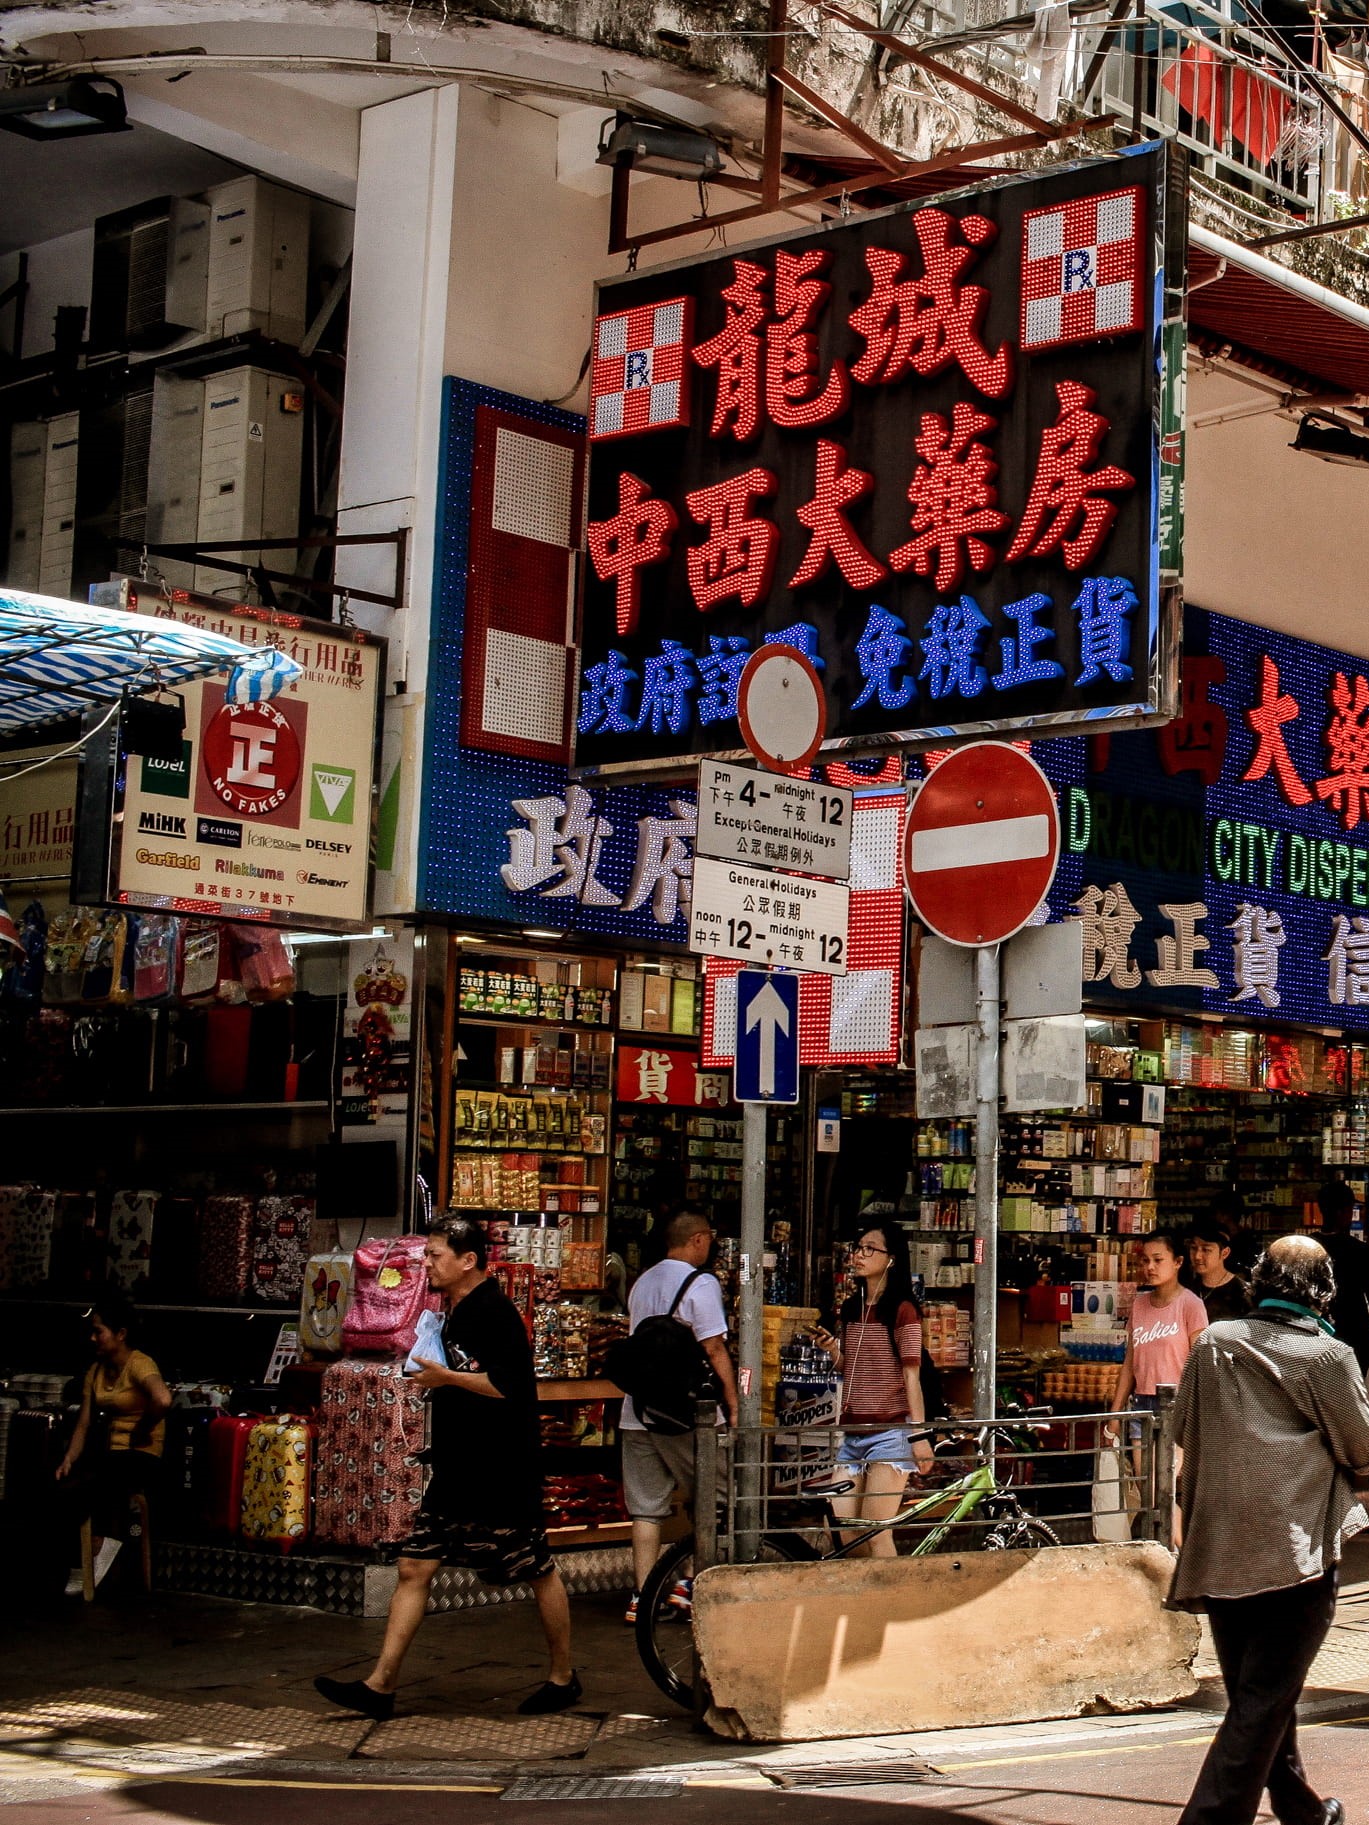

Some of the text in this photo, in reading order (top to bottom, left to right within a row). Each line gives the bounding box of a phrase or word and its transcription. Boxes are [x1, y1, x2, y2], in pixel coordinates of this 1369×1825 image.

[691, 207, 1014, 442] 龍城
[587, 378, 1135, 637] 中西大藥房
[212, 776, 287, 814] NO FAKES
[709, 786, 807, 823] 下午 午夜
[714, 770, 844, 826] pm midnight 12
[305, 838, 353, 855] DELSEY
[714, 811, 837, 848] Except General Holidays
[135, 847, 201, 871] Garfield
[736, 836, 815, 867] 公眾假期例外
[1213, 818, 1281, 889] CITY
[215, 858, 285, 882] Rilakkuma
[728, 870, 818, 899] General Holidays
[742, 894, 801, 921] 公眾假期
[694, 928, 805, 962] 中午 午夜
[695, 910, 722, 925] noon
[769, 922, 816, 941] midnight
[819, 934, 844, 965] 12
[779, 1400, 834, 1427] Knoppers
